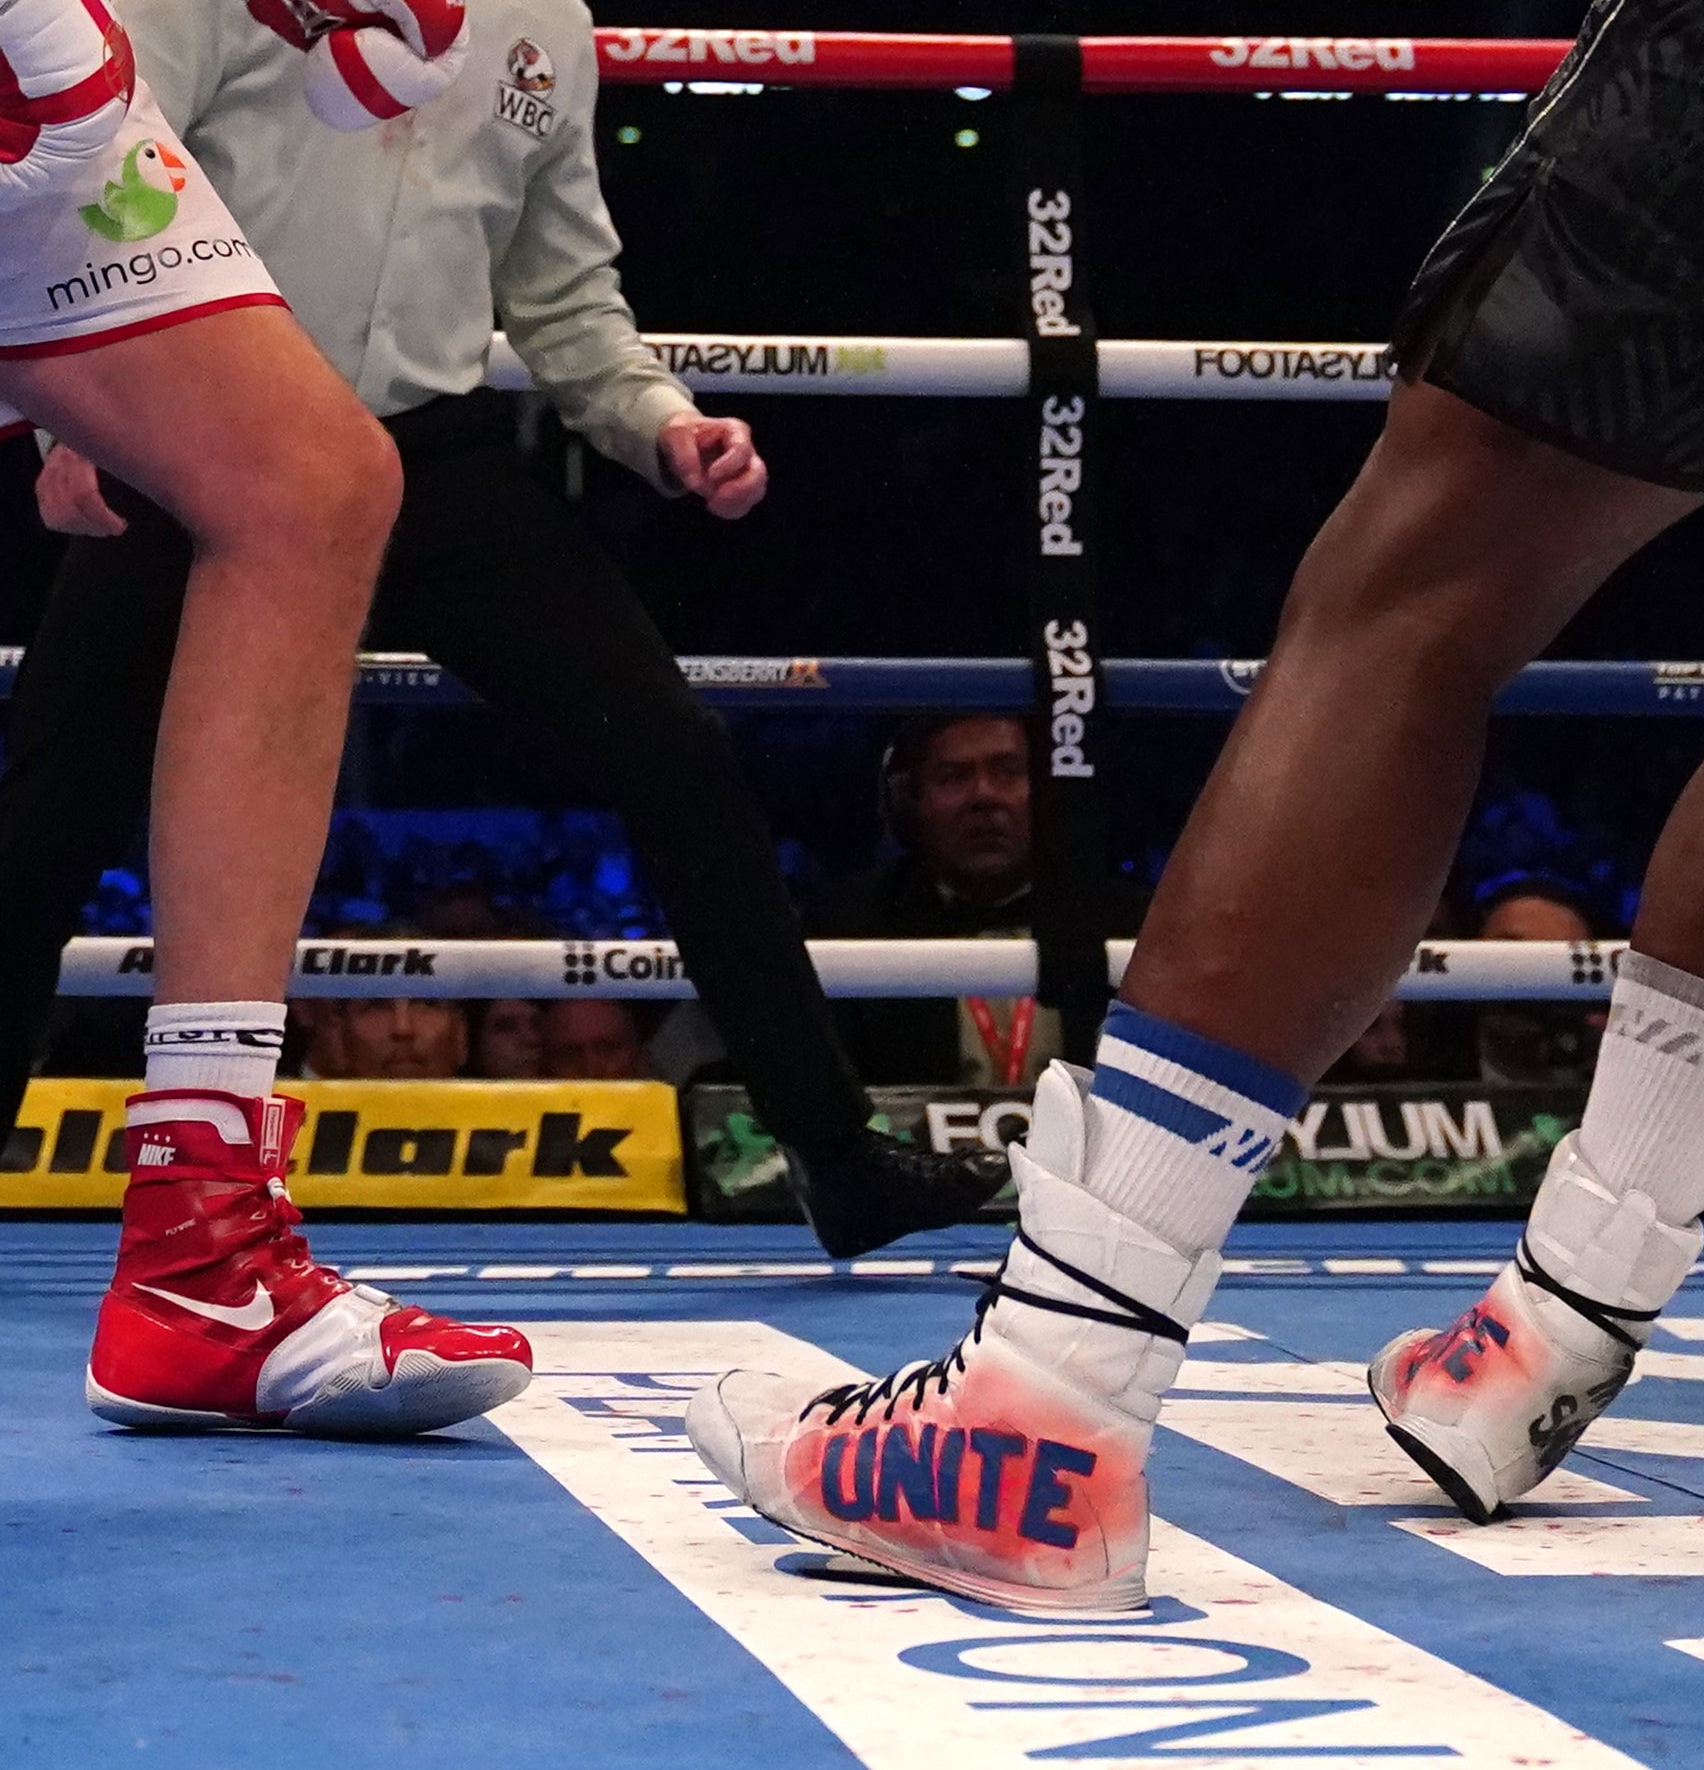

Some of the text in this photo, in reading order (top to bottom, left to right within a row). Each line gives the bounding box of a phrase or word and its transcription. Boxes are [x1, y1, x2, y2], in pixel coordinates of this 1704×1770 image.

[605, 29, 815, 65] 32Red
[499, 86, 554, 137] WBC
[47, 237, 254, 310] mingo.com
[1027, 188, 1081, 338] 32Red
[1039, 395, 1087, 557] 32Red
[1043, 619, 1095, 778] 32Red
[301, 947, 437, 976] Clark
[137, 1142, 177, 1166] NIKE
[290, 1108, 641, 1177] lark
[821, 1423, 1097, 1549] UNITE
